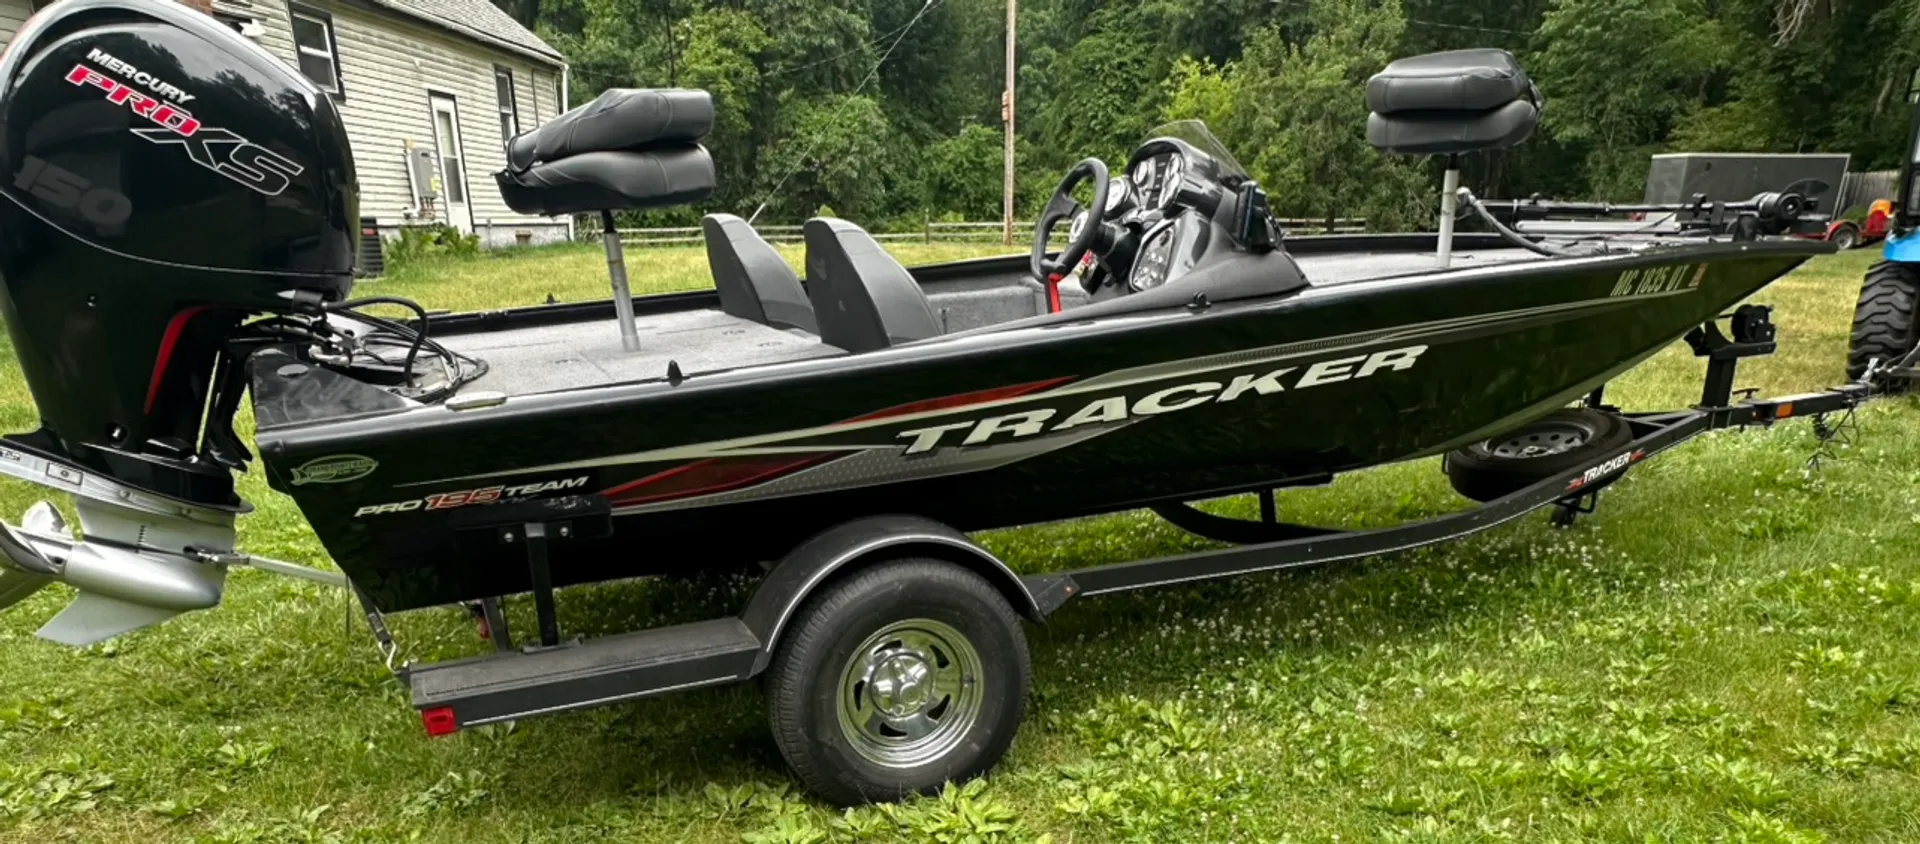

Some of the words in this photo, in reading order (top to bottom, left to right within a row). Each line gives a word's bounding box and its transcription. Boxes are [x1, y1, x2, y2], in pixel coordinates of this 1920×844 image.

[65, 64, 200, 137] PRO
[86, 48, 196, 105] MERCURY
[13, 154, 133, 225] 150
[129, 127, 304, 196] XS
[1610, 269, 1639, 297] MC
[896, 344, 1429, 455] TRACKER
[354, 499, 423, 517] PRO
[424, 485, 505, 511] 195
[505, 476, 590, 497] TEAM
[1583, 451, 1632, 484] TRACKER
